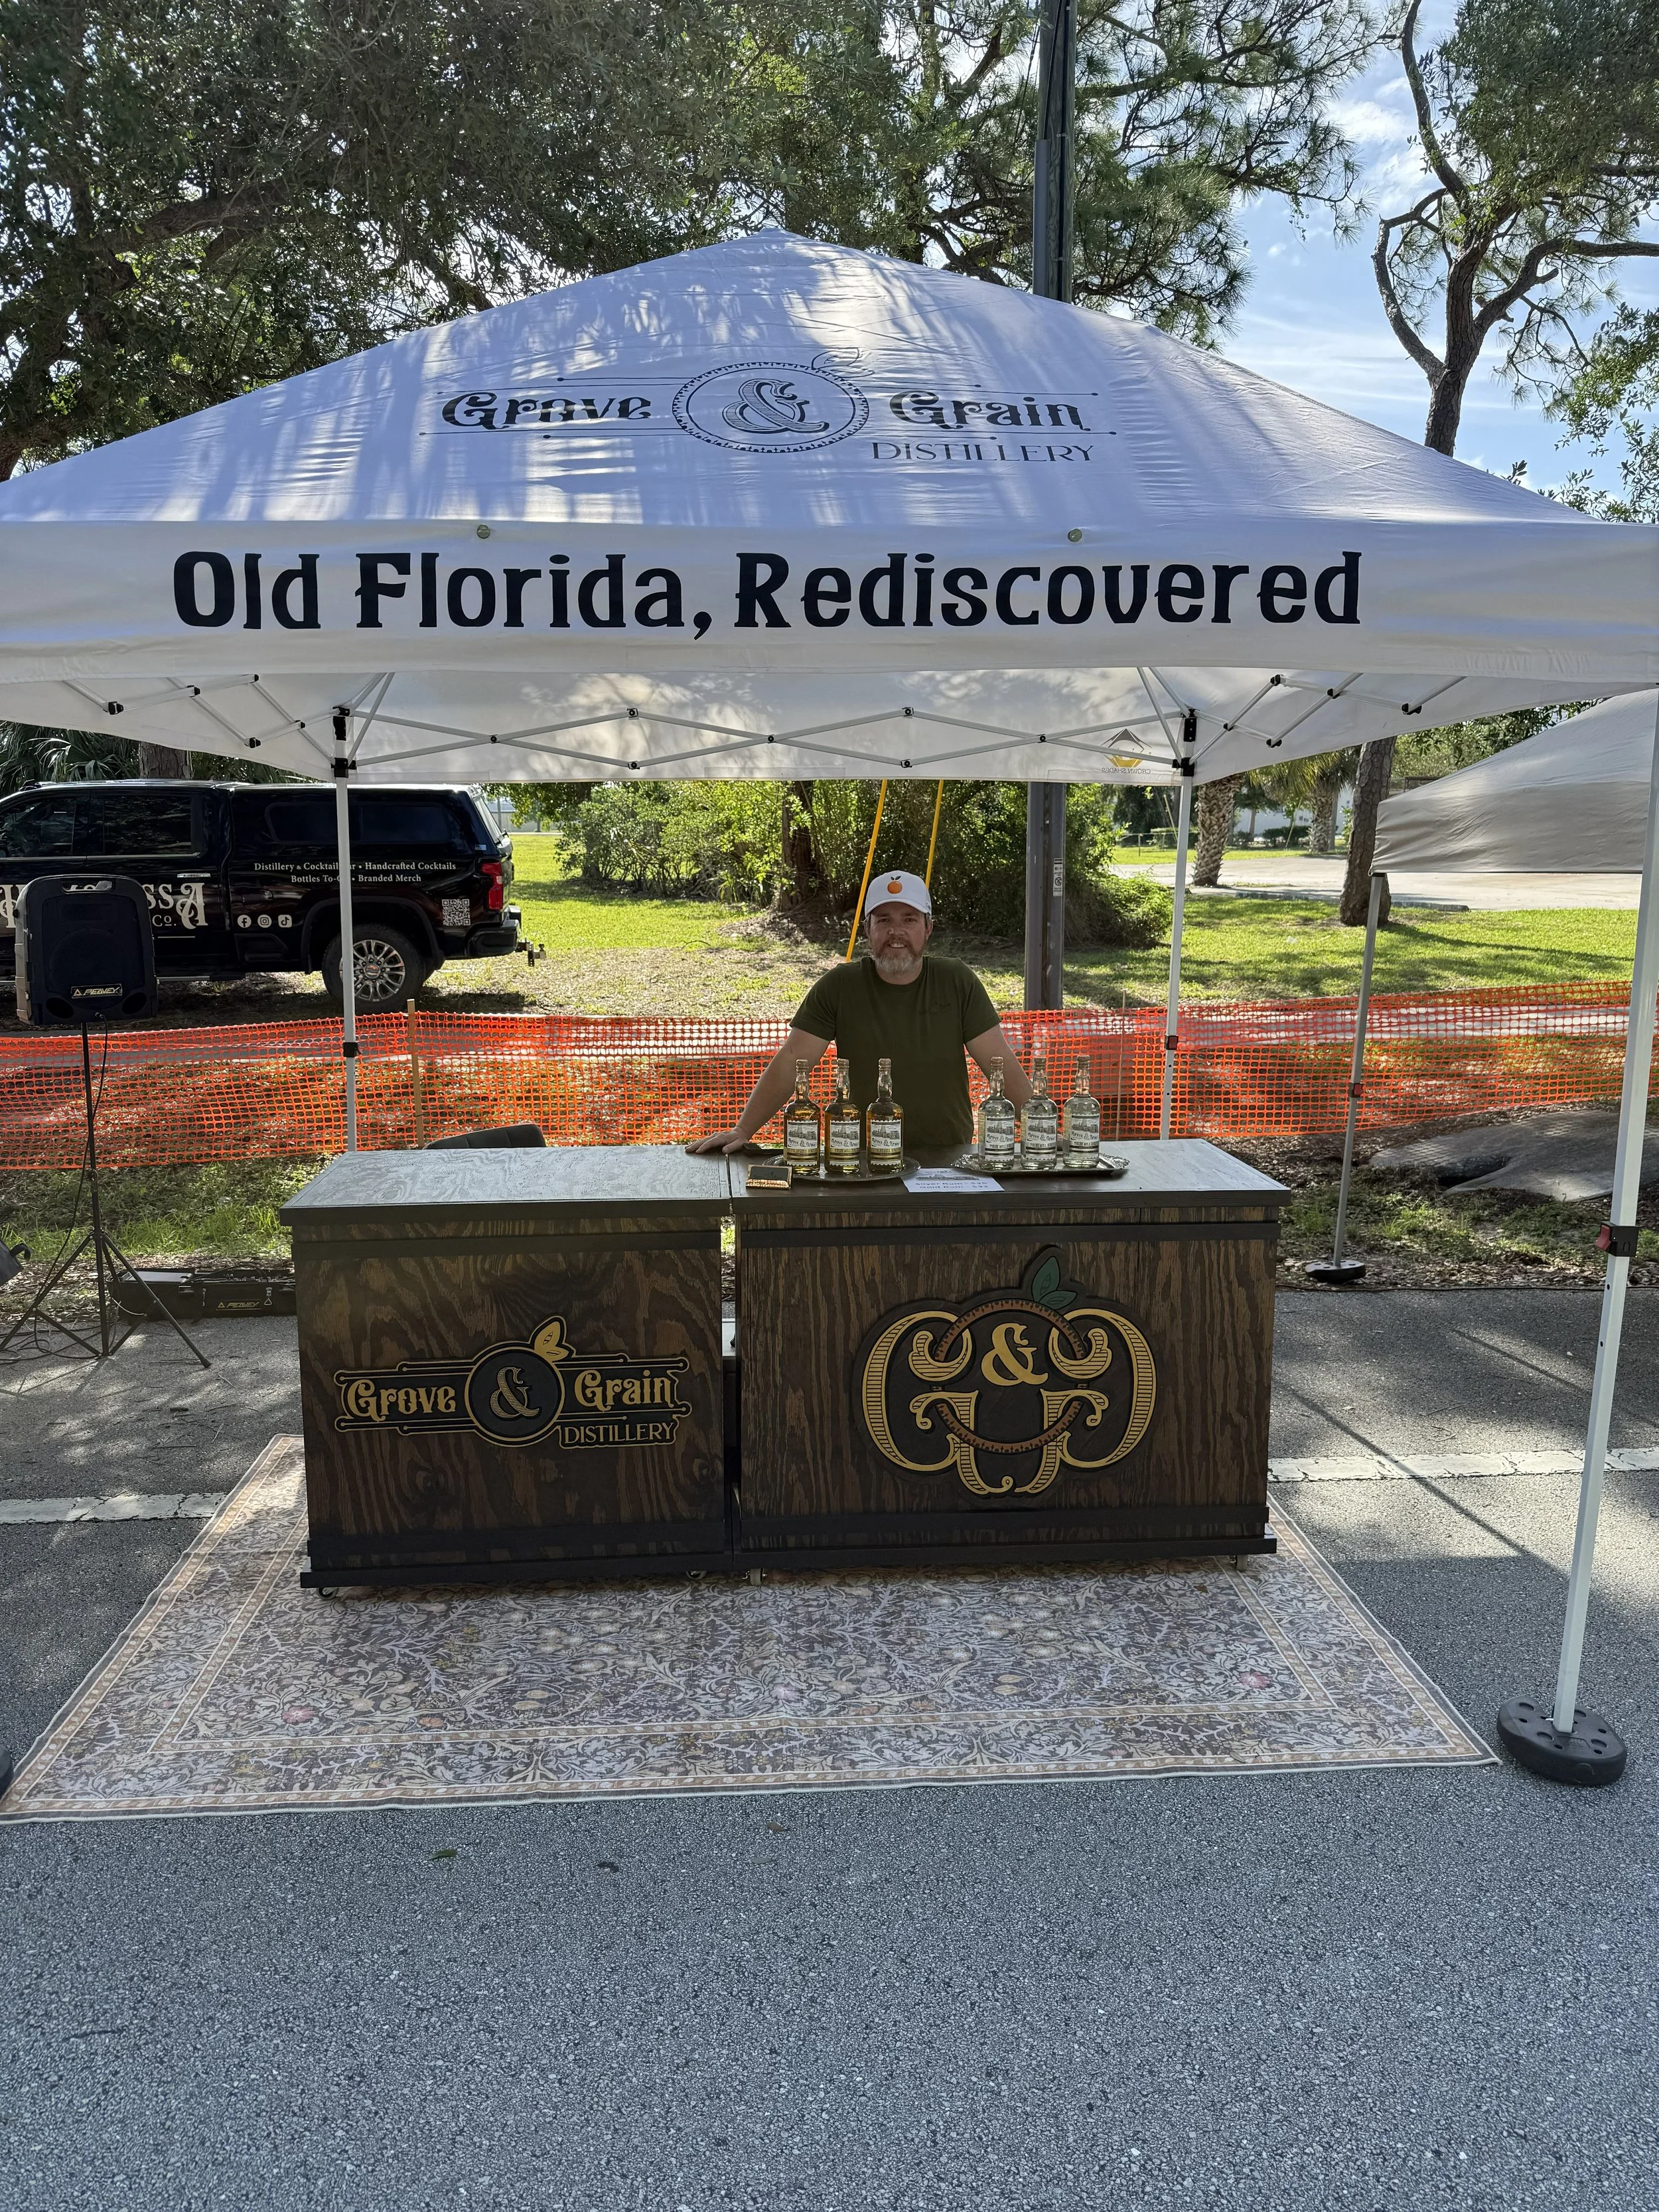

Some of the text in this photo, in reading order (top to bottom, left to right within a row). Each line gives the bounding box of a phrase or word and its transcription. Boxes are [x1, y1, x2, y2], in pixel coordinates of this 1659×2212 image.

[442, 378, 1090, 433] Grove & Grain
[873, 441, 1094, 462] DISTILLERY
[173, 550, 1362, 640] Old Florida, Rediscovered
[254, 862, 295, 872] Distillery
[83, 986, 120, 995] PEAVEY
[346, 1366, 676, 1423] Grove & Grain
[563, 1422, 676, 1445] DISTILLERY
